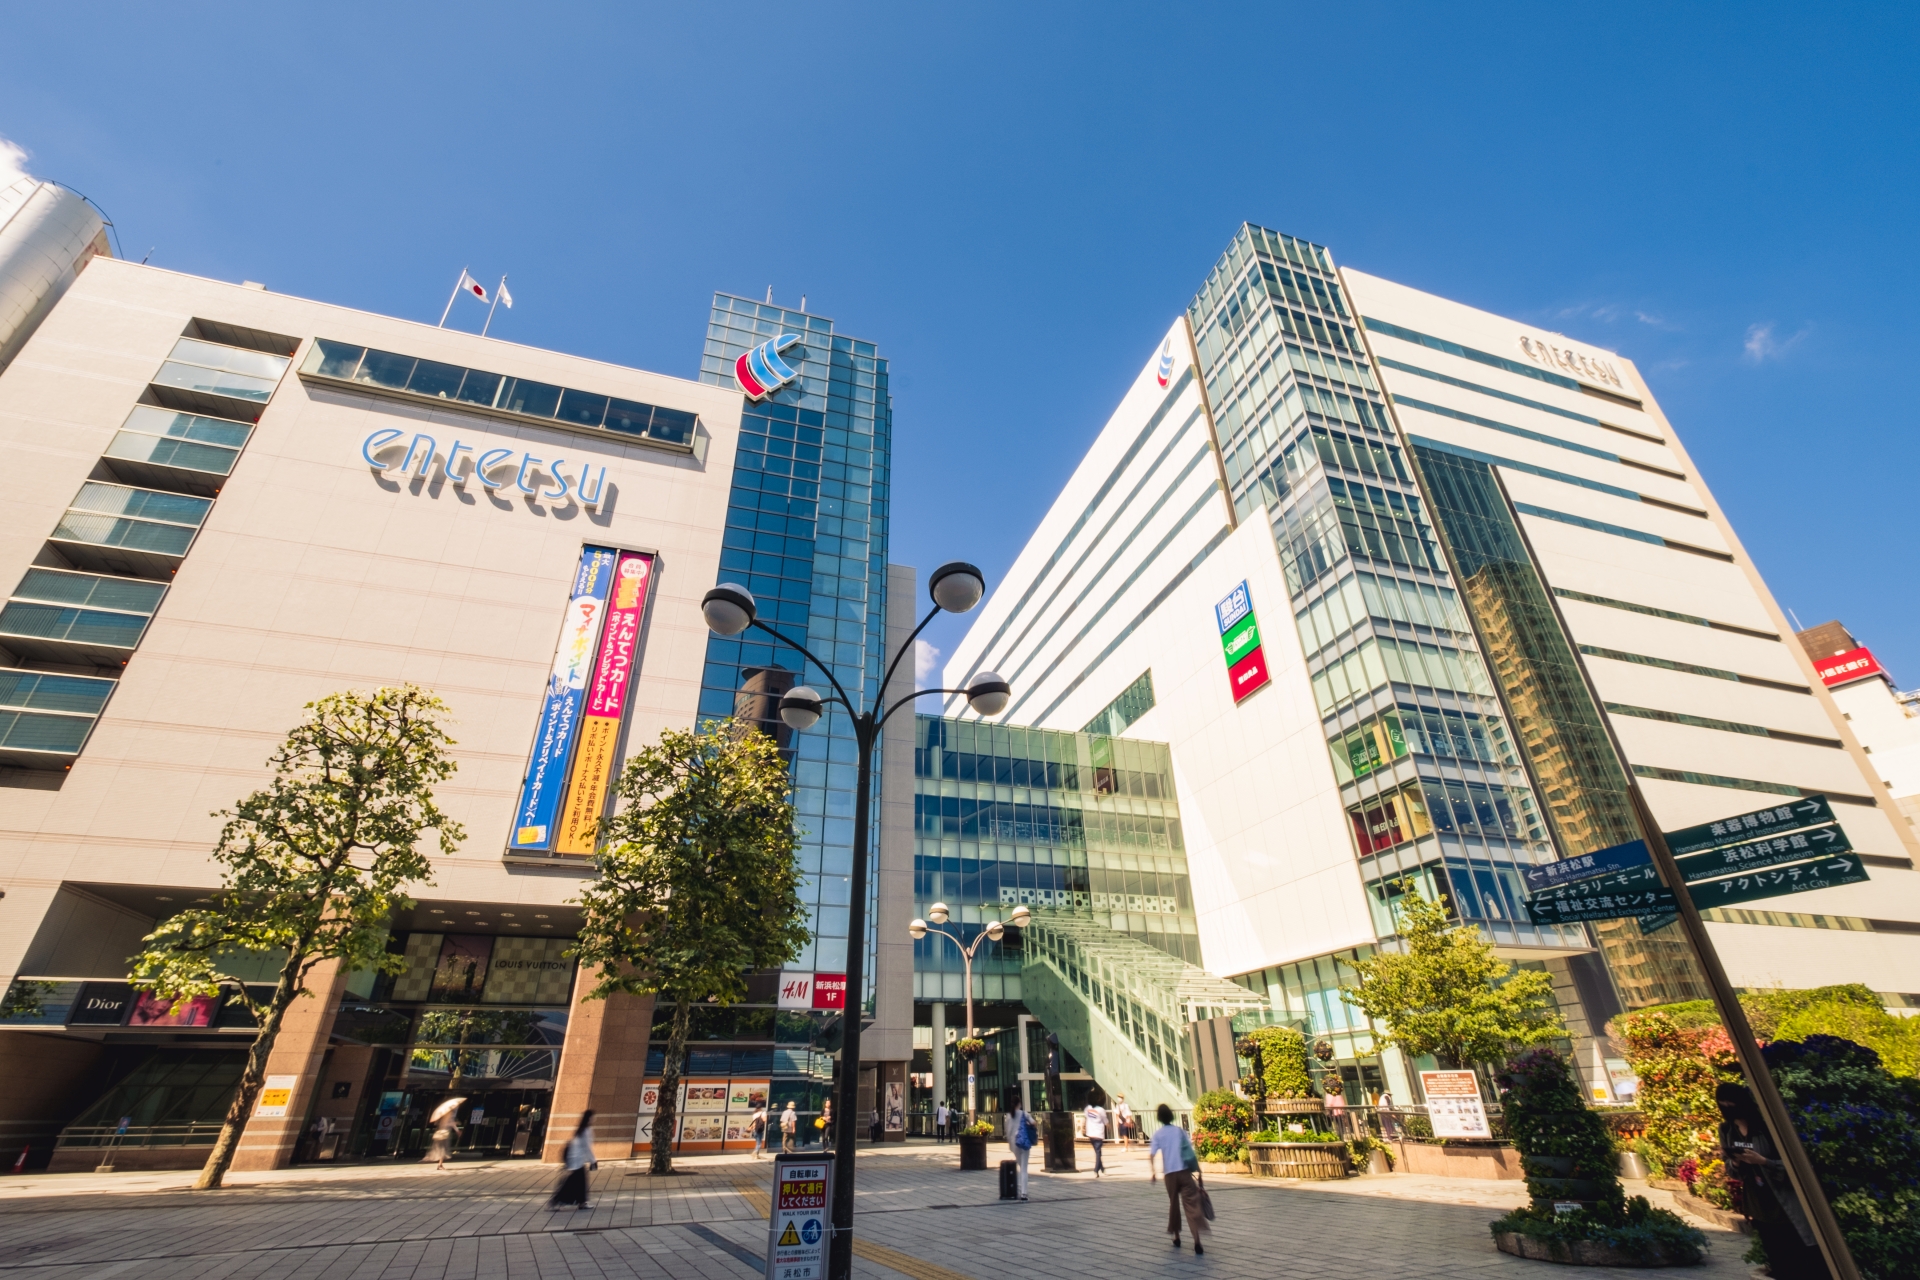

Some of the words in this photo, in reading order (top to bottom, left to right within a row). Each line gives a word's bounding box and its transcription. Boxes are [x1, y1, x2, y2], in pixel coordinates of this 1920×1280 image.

[362, 428, 607, 504] entetsu
[568, 603, 596, 683] マイナポイント
[604, 613, 635, 712] えんてつカード
[554, 696, 574, 758] えんてつカード
[1710, 806, 1794, 836] 楽器博物館
[1675, 840, 1715, 854] Hamamatsu
[1715, 833, 1746, 846] Museum
[1746, 830, 1755, 839] of
[1755, 821, 1800, 837] Instruments
[1722, 835, 1810, 863] 浜松科学館
[1545, 855, 1596, 877] 新浜松駅
[1549, 865, 1607, 885] Shin-Hamamatsu
[1607, 862, 1622, 871] Stn.
[1688, 865, 1738, 880] Hamamatsu
[1738, 858, 1773, 871] Science
[1774, 850, 1815, 864] Museum
[1555, 868, 1656, 899] ギャラリーモール
[1719, 867, 1820, 893] アクトシティ
[1791, 882, 1808, 892] Act
[1809, 879, 1830, 890] City
[1555, 892, 1672, 913] 福祉交流センター
[1559, 913, 1581, 922] Social
[1581, 910, 1609, 920] Welfare
[1609, 909, 1618, 917] &
[1617, 907, 1651, 917] Exchange
[1652, 904, 1677, 912] Center
[494, 960, 523, 969] LOUIS
[526, 961, 567, 970] VUITTON
[781, 980, 809, 999] H&M
[826, 992, 837, 1001] 1F
[86, 998, 123, 1010] Dior
[789, 1169, 819, 1179] 自転車は
[782, 1182, 824, 1195] 押して通行
[781, 1196, 823, 1208] してください
[783, 1268, 812, 1278] 浜松市
